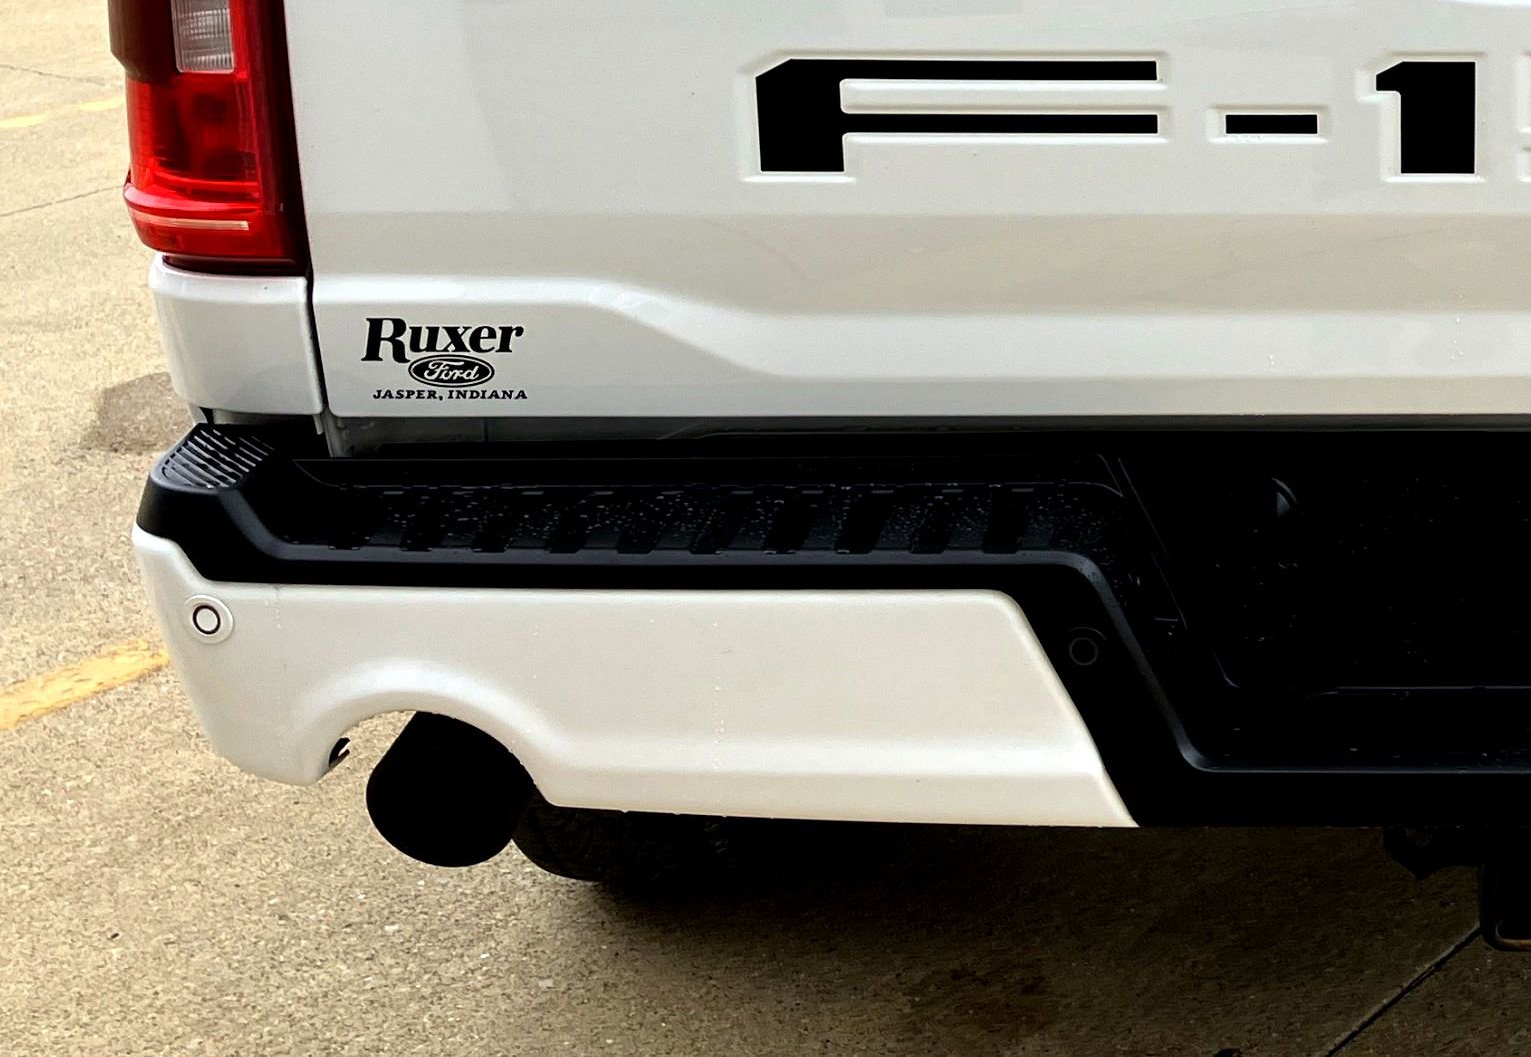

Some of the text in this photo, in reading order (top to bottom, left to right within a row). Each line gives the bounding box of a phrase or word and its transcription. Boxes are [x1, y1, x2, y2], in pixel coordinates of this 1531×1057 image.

[361, 317, 525, 364] Ruxer
[424, 360, 480, 381] Ford
[372, 389, 528, 401] JASPER, INDIANA
